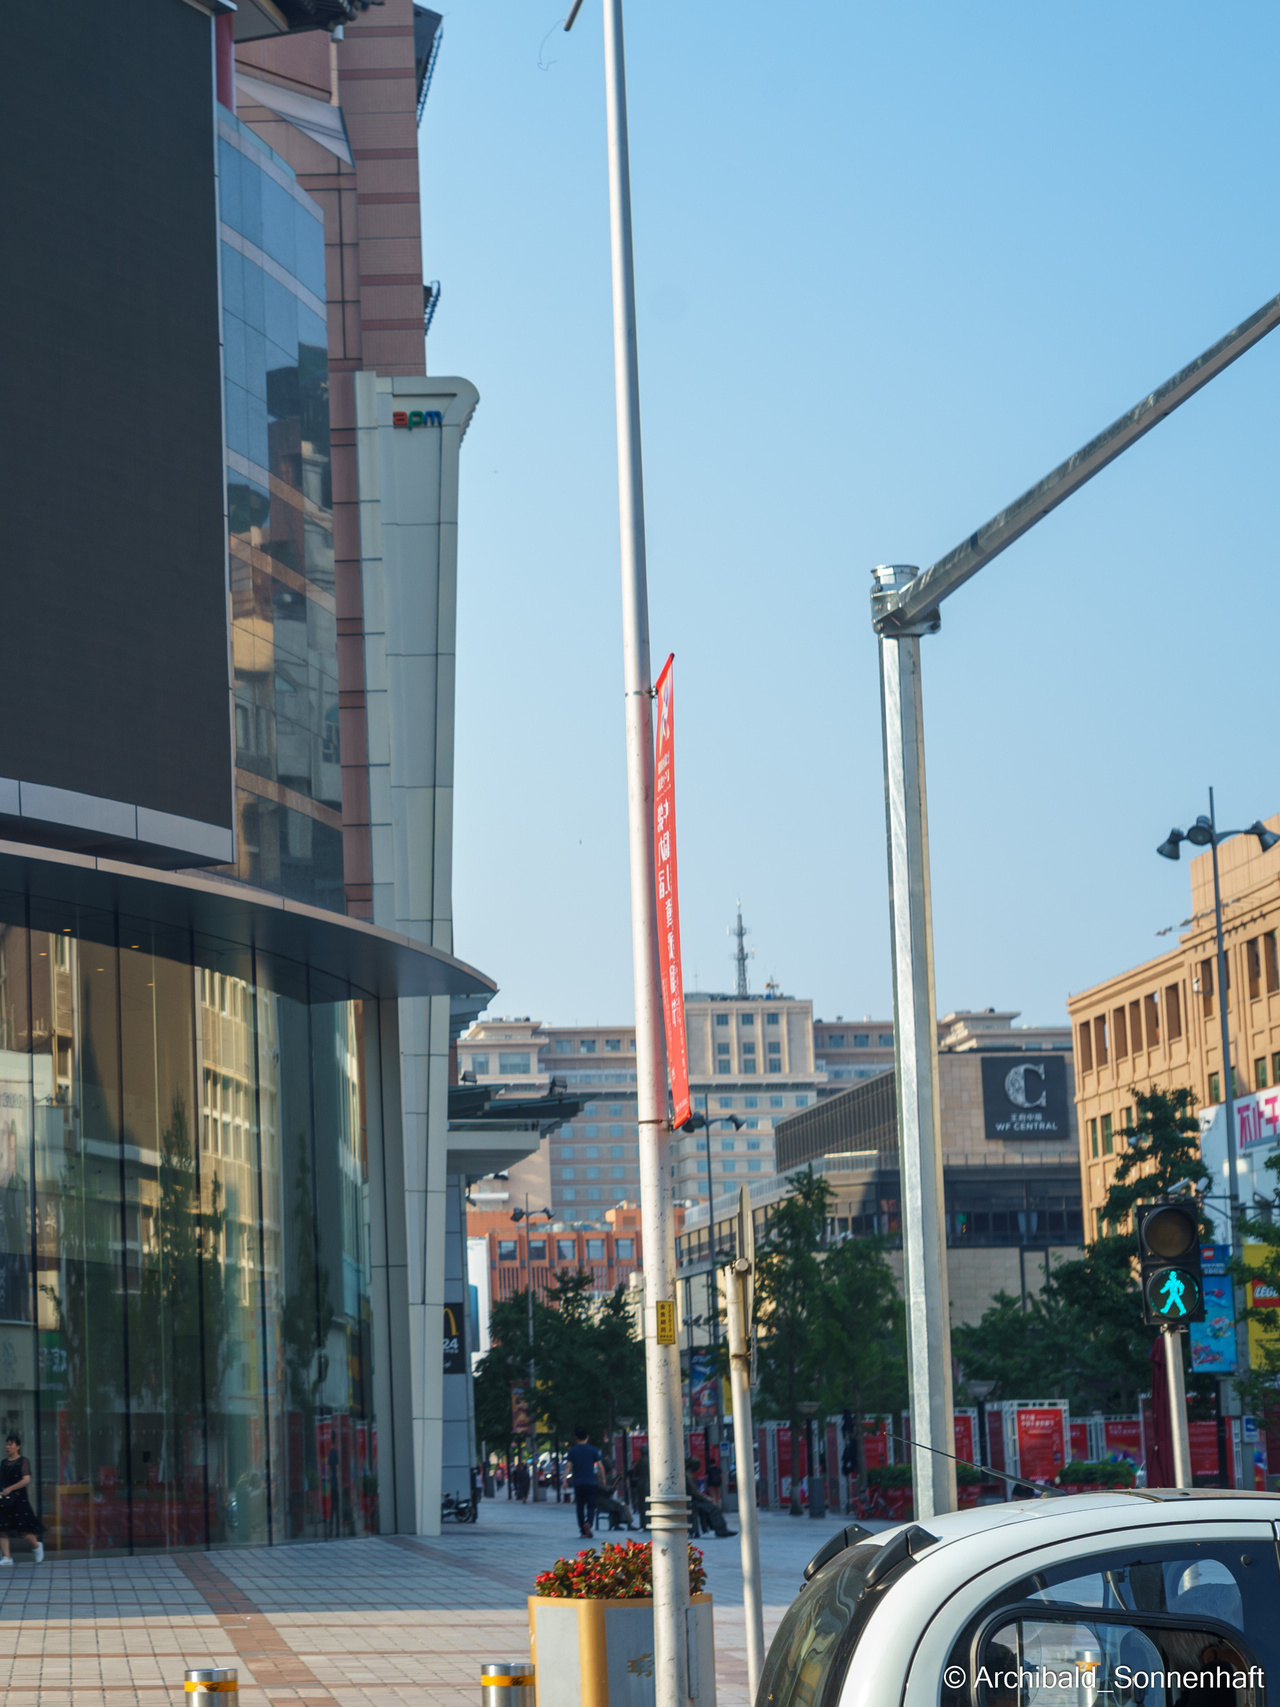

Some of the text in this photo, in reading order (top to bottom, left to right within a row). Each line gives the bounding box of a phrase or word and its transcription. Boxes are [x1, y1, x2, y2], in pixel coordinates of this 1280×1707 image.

[393, 410, 442, 430] apm
[995, 1121, 1058, 1132] WF CENTRAL
